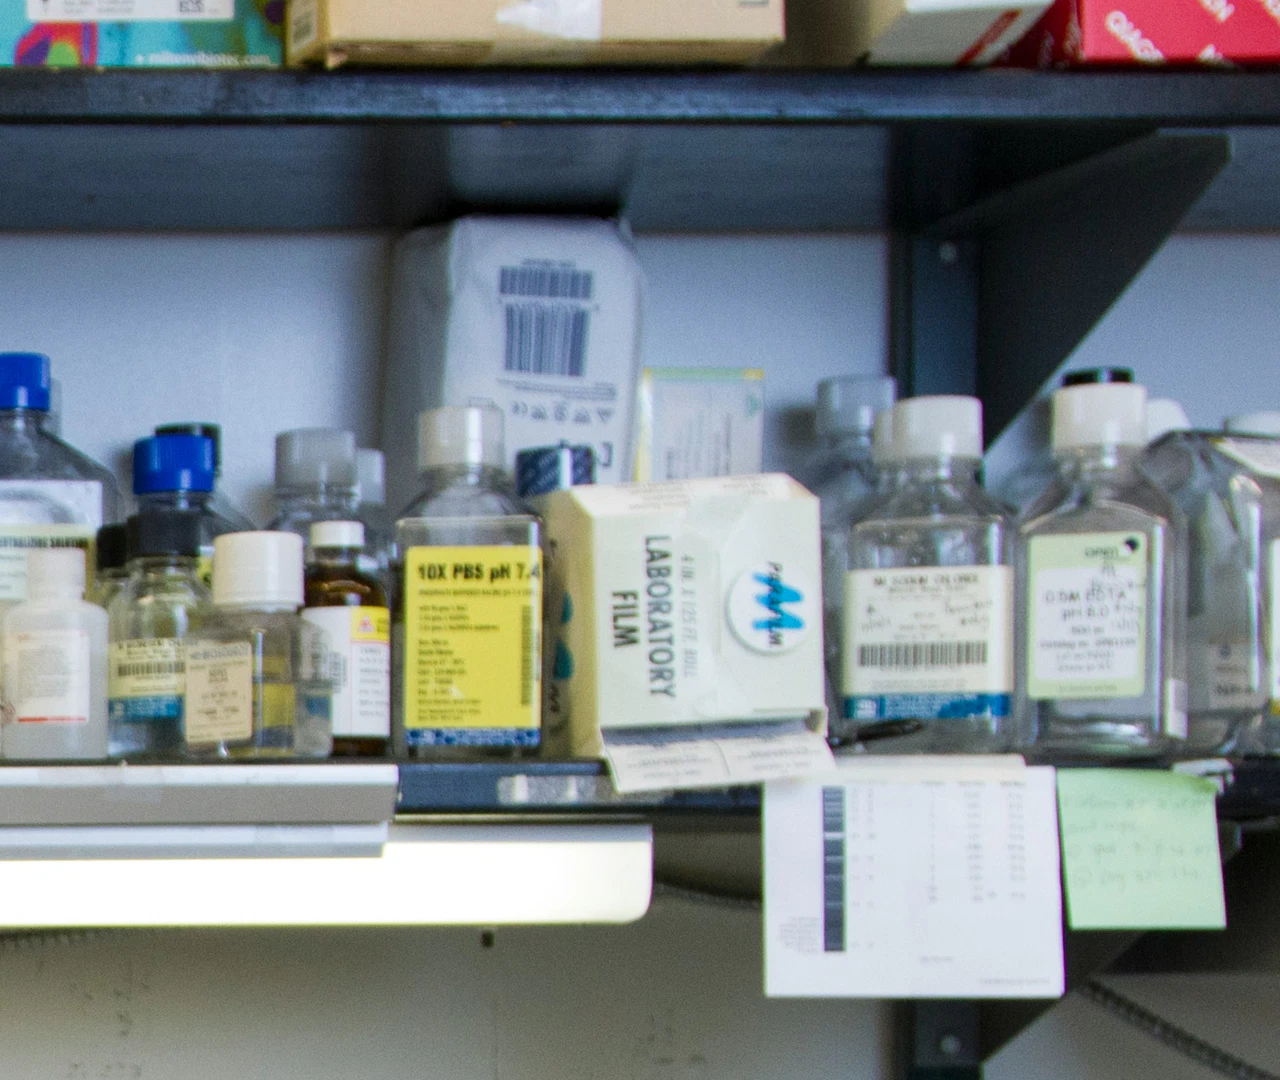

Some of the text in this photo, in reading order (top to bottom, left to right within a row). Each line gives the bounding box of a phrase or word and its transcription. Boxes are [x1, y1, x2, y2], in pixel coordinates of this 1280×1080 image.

[418, 563, 446, 580] 10X
[452, 563, 485, 580] PBS
[490, 563, 511, 583] pH
[612, 590, 640, 649] FILM
[645, 535, 676, 698] LABORATORY
